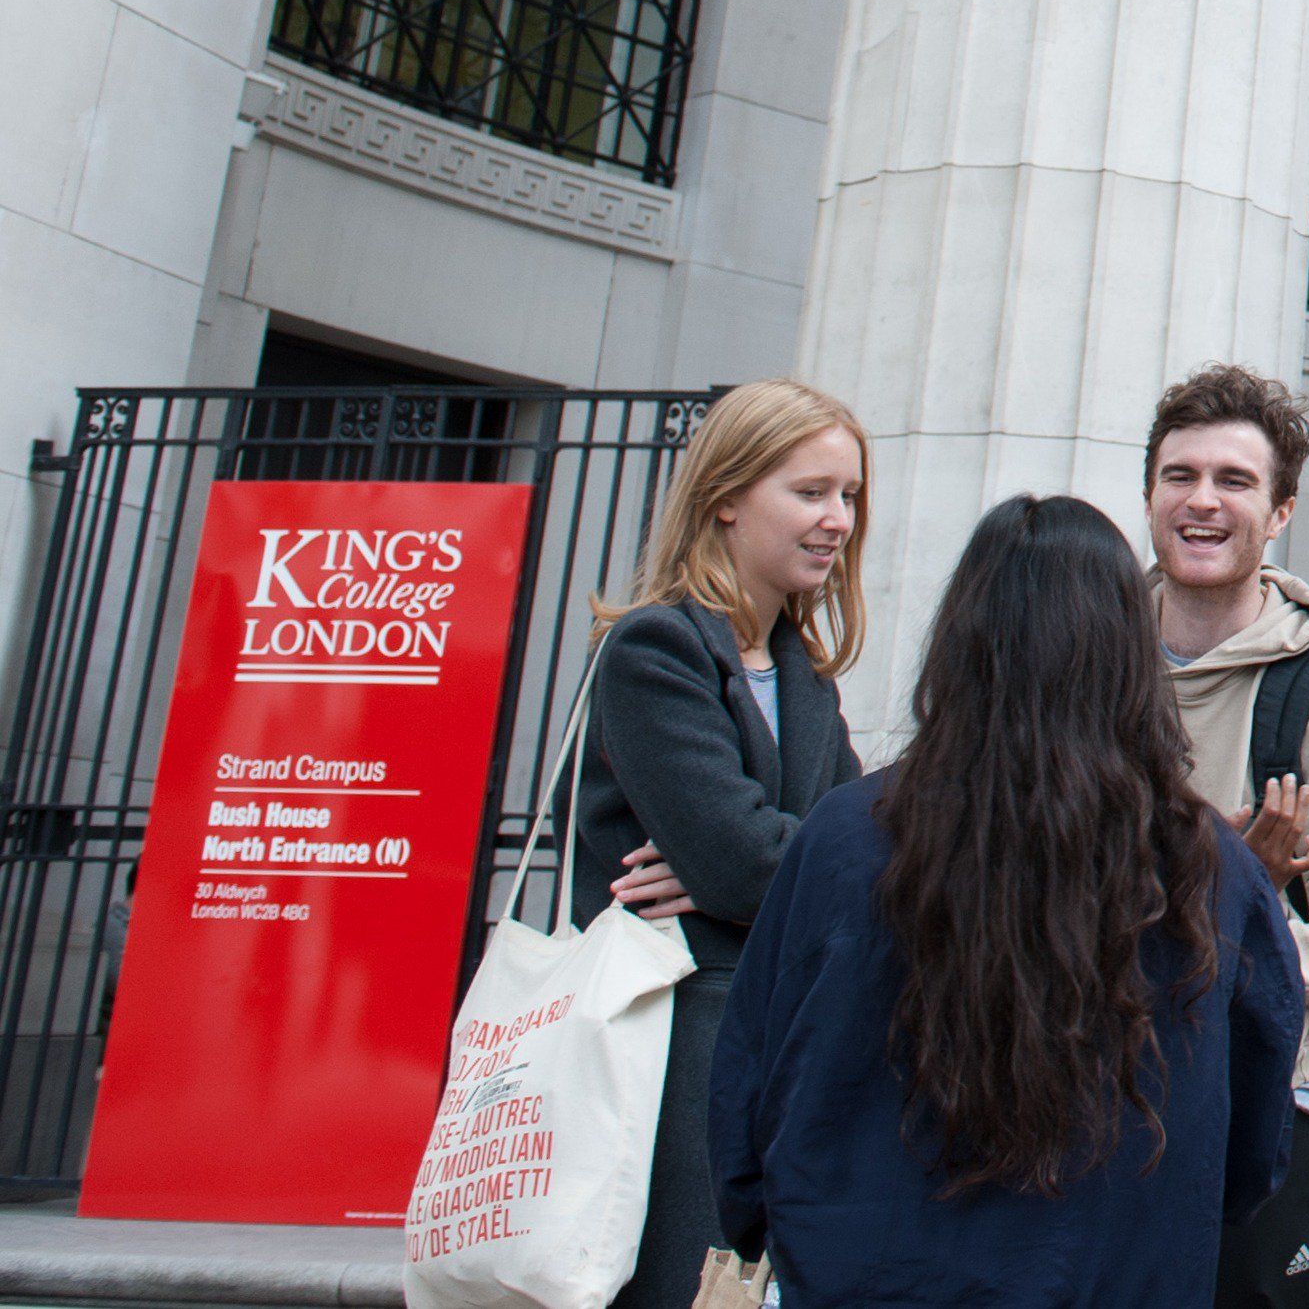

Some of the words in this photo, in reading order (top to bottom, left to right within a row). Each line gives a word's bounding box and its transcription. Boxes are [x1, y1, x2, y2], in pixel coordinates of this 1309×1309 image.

[246, 529, 463, 608] KING'S
[316, 572, 455, 618] College
[240, 619, 451, 658] LONDON
[217, 754, 292, 780] Strand
[295, 755, 387, 786] Campus
[208, 801, 261, 828] Bush
[264, 802, 331, 828] House
[201, 835, 266, 862] North
[269, 836, 371, 864] Entrance
[375, 837, 411, 866] (N)
[195, 882, 213, 899] 30
[213, 883, 267, 902] Aldwych
[191, 903, 239, 920] London
[240, 903, 280, 920] WC2B
[281, 904, 310, 921] 4BG
[416, 1131, 553, 1188] O/MODIGLIANI
